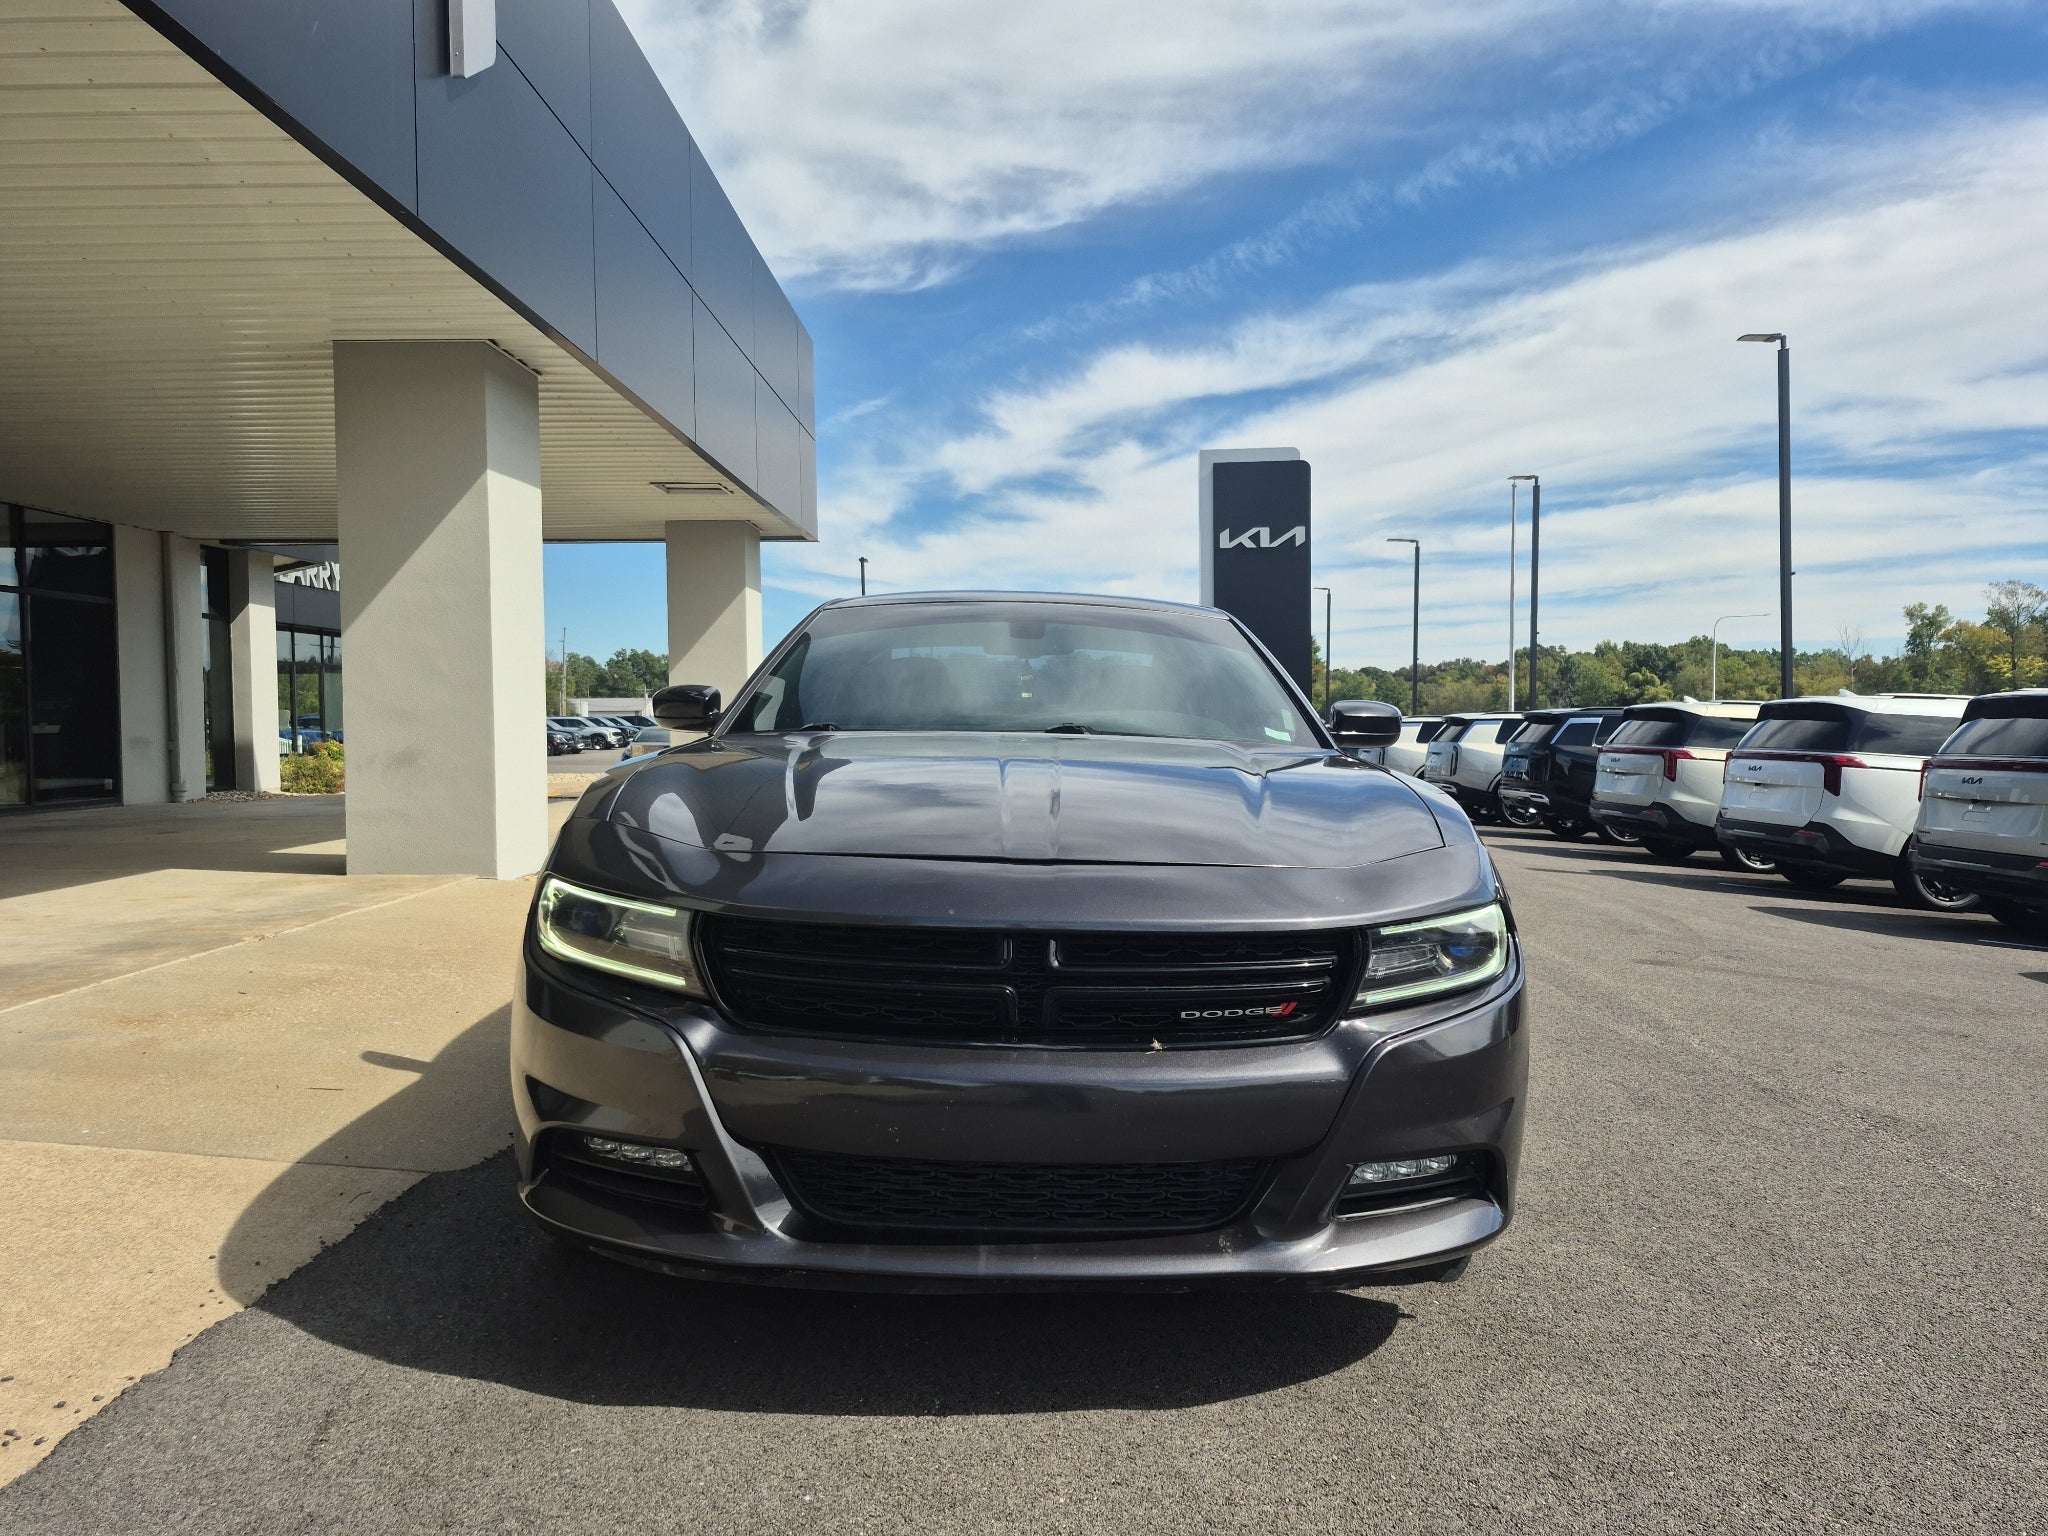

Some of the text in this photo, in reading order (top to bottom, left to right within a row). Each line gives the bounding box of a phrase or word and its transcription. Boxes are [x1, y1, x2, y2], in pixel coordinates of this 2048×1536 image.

[1220, 526, 1305, 548] KIA
[1962, 776, 1983, 785] KIA
[1180, 1006, 1282, 1019] DODGE
